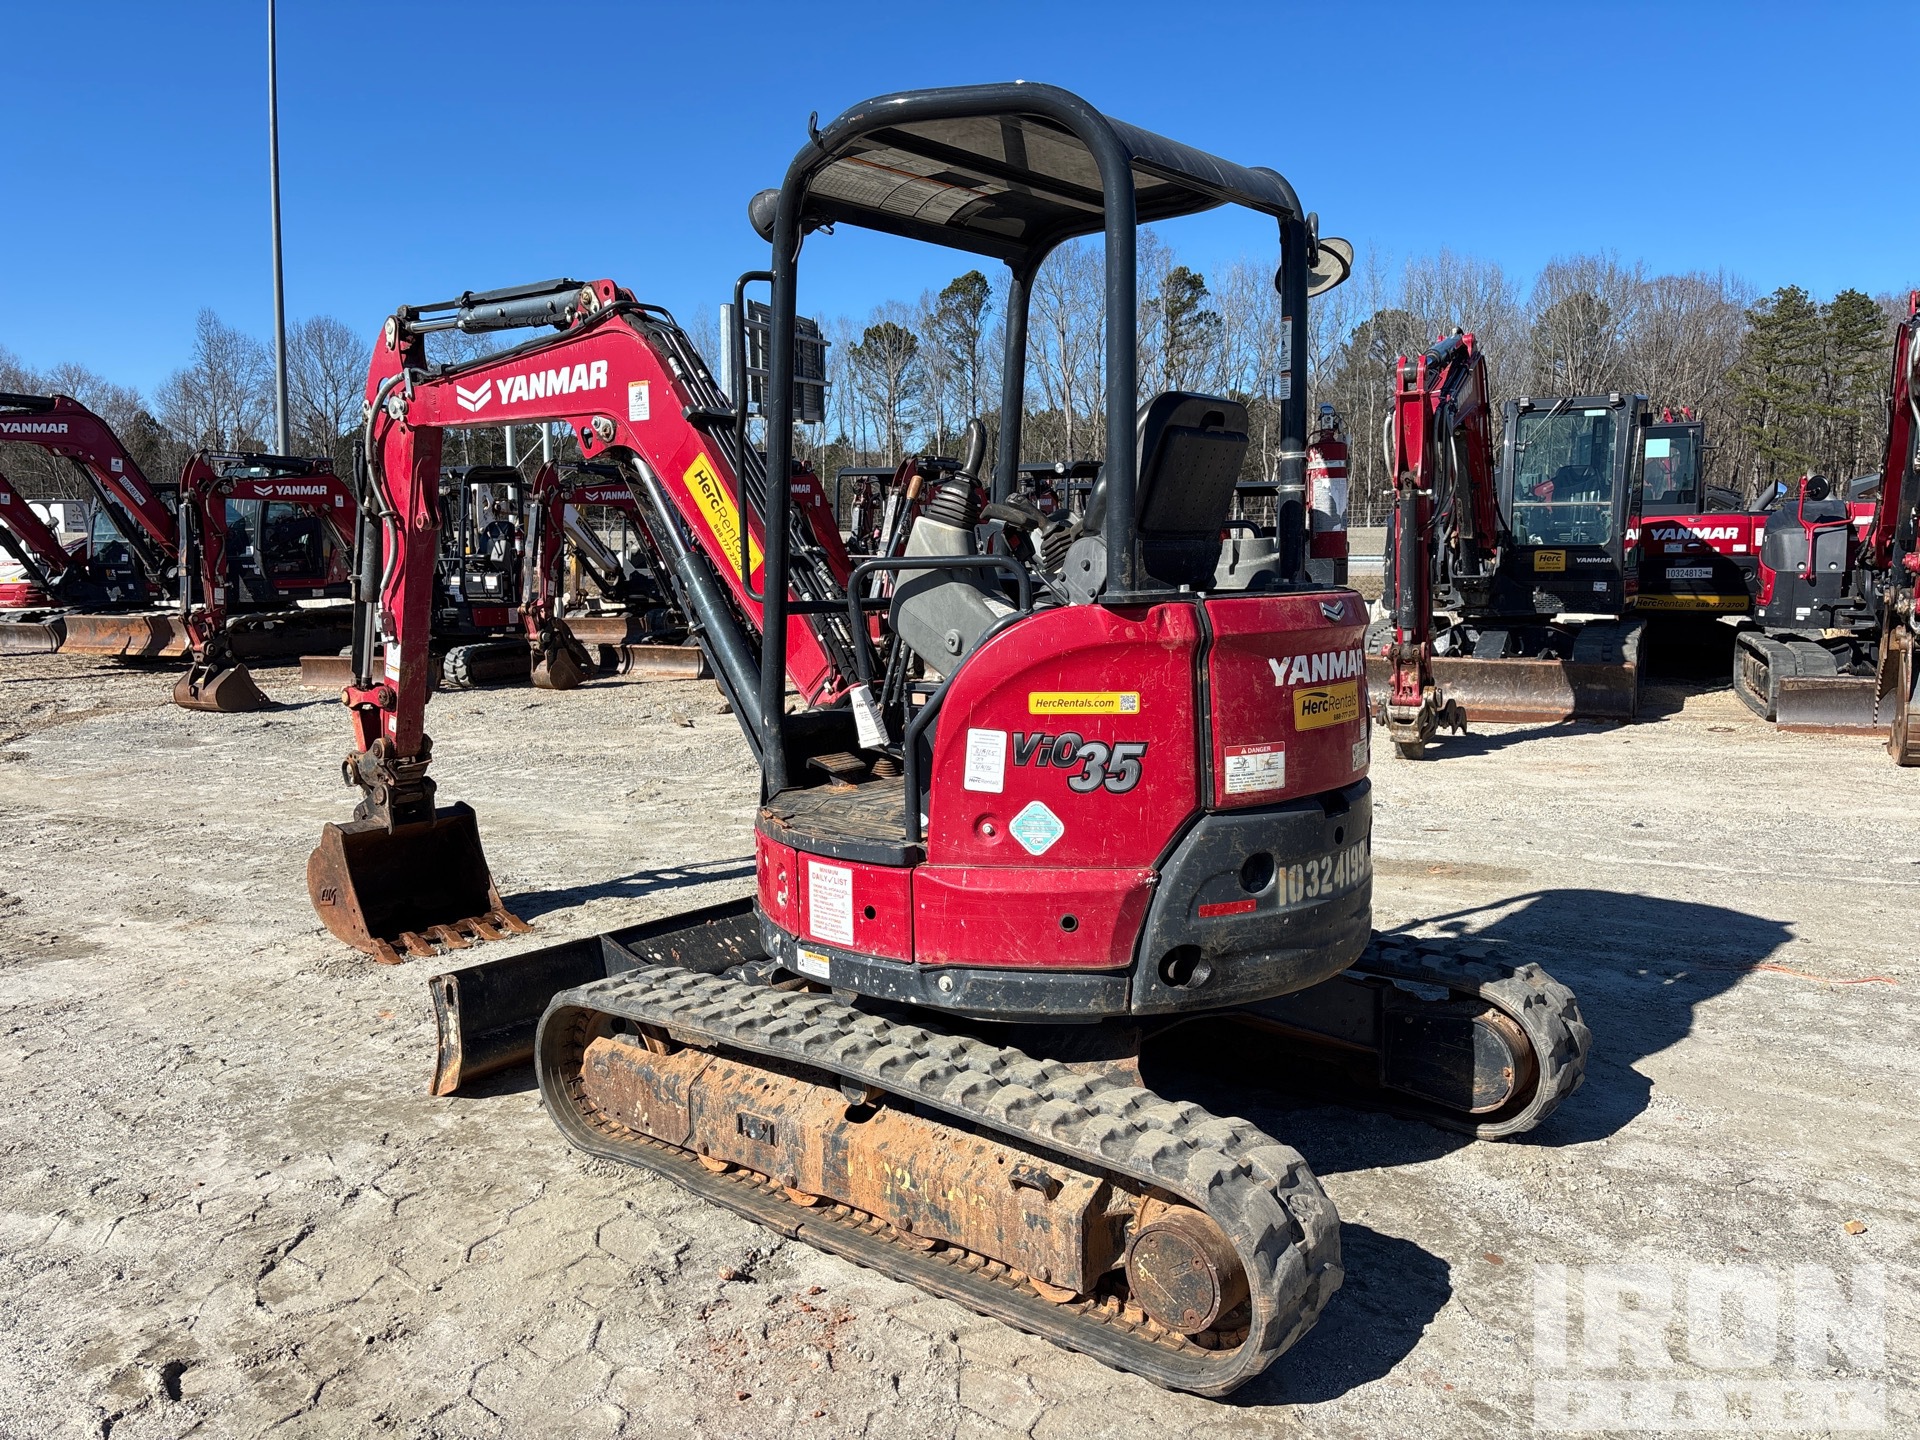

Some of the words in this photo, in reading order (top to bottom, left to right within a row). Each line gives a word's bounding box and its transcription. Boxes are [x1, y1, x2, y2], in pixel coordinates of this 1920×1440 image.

[497, 360, 608, 405] YANMAR
[0, 422, 68, 433] YANMAR
[275, 485, 327, 495] YANMAR
[790, 484, 811, 493] NMAR
[1651, 527, 1739, 540] YANMAR
[1666, 569, 1703, 578] 10324813
[1636, 598, 1691, 608] HercRentals
[1268, 649, 1364, 686] YANMAR
[1035, 699, 1114, 708] HercRentals.com
[1302, 690, 1357, 716] HercRentals
[1248, 746, 1271, 754] DANGER
[811, 872, 828, 882] DAILY
[834, 878, 847, 886] LIST
